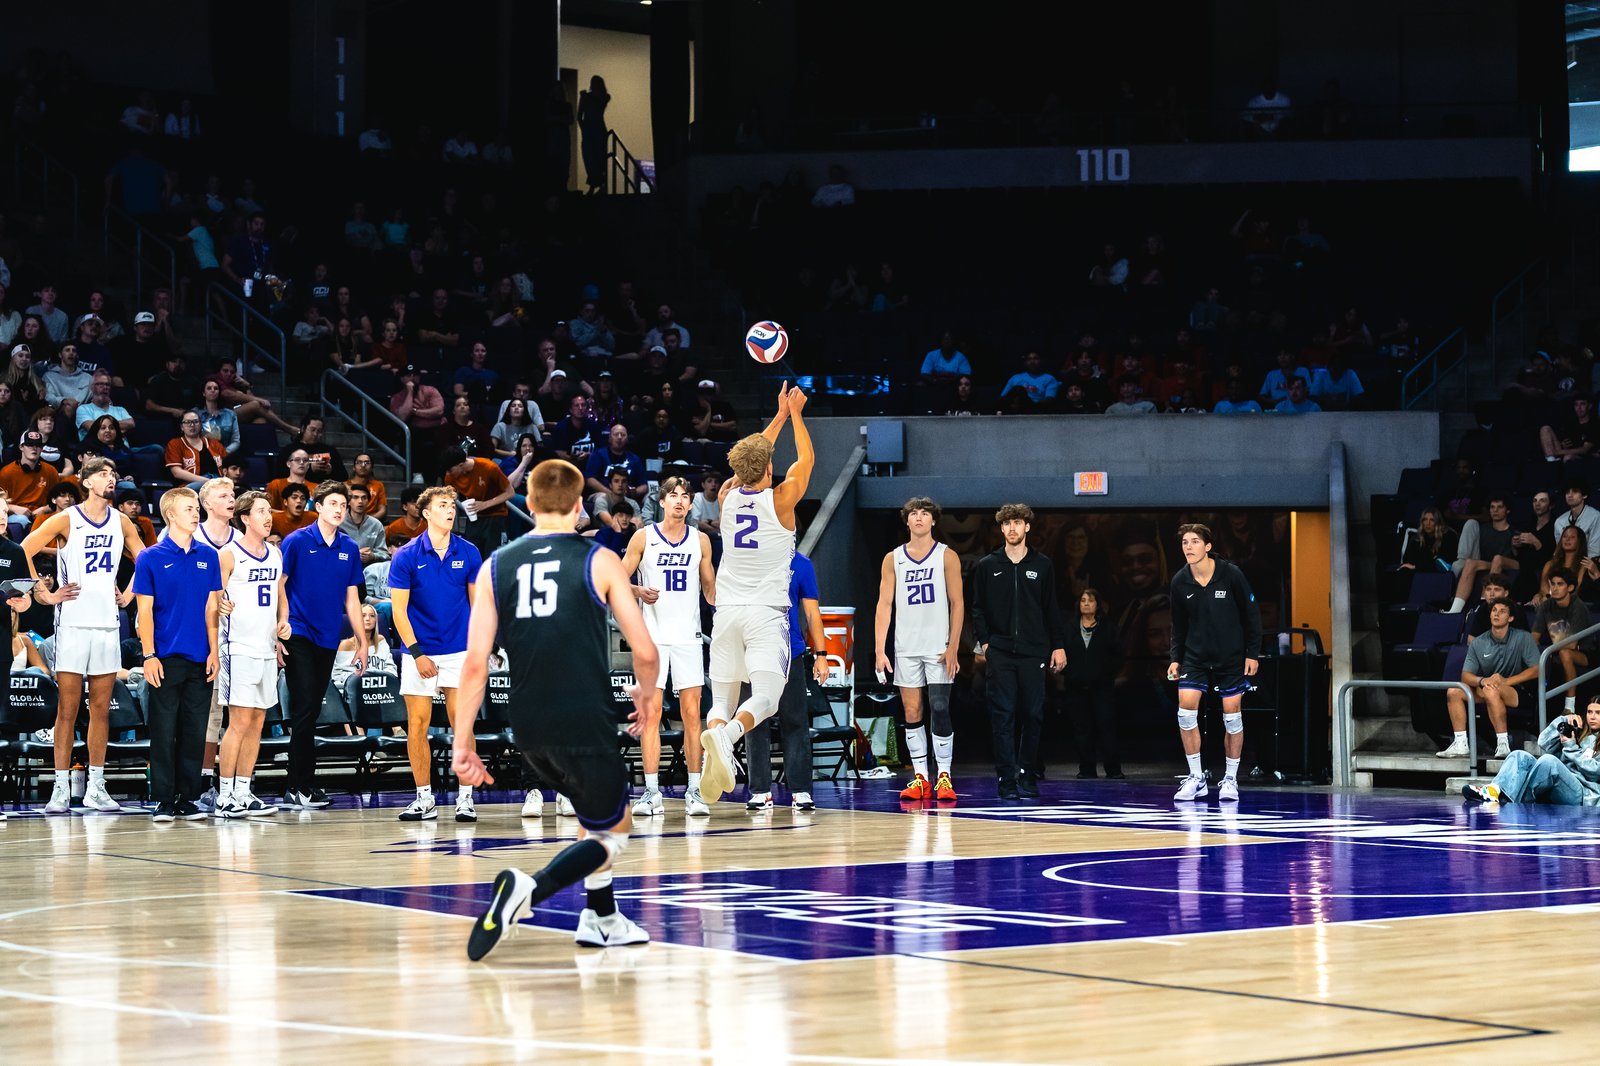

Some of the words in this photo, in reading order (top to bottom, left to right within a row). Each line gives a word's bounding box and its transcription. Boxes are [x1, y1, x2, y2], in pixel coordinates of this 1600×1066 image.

[1075, 148, 1130, 181] 110
[1080, 473, 1103, 491] EXIT
[734, 514, 759, 549] 2
[84, 535, 113, 549] GCU
[85, 551, 114, 574] 24
[656, 553, 692, 566] GCU
[248, 568, 277, 582] GCU
[663, 569, 687, 592] 18
[905, 568, 934, 583] GCU
[258, 585, 271, 607] 6
[515, 560, 561, 619] 15
[907, 583, 936, 606] 20
[10, 677, 39, 689] GCU
[362, 676, 387, 689] GCU
[489, 677, 511, 688] GCU
[610, 675, 633, 687] GCU
[9, 694, 45, 702] GLOBAL
[362, 692, 395, 700] GLOBAL
